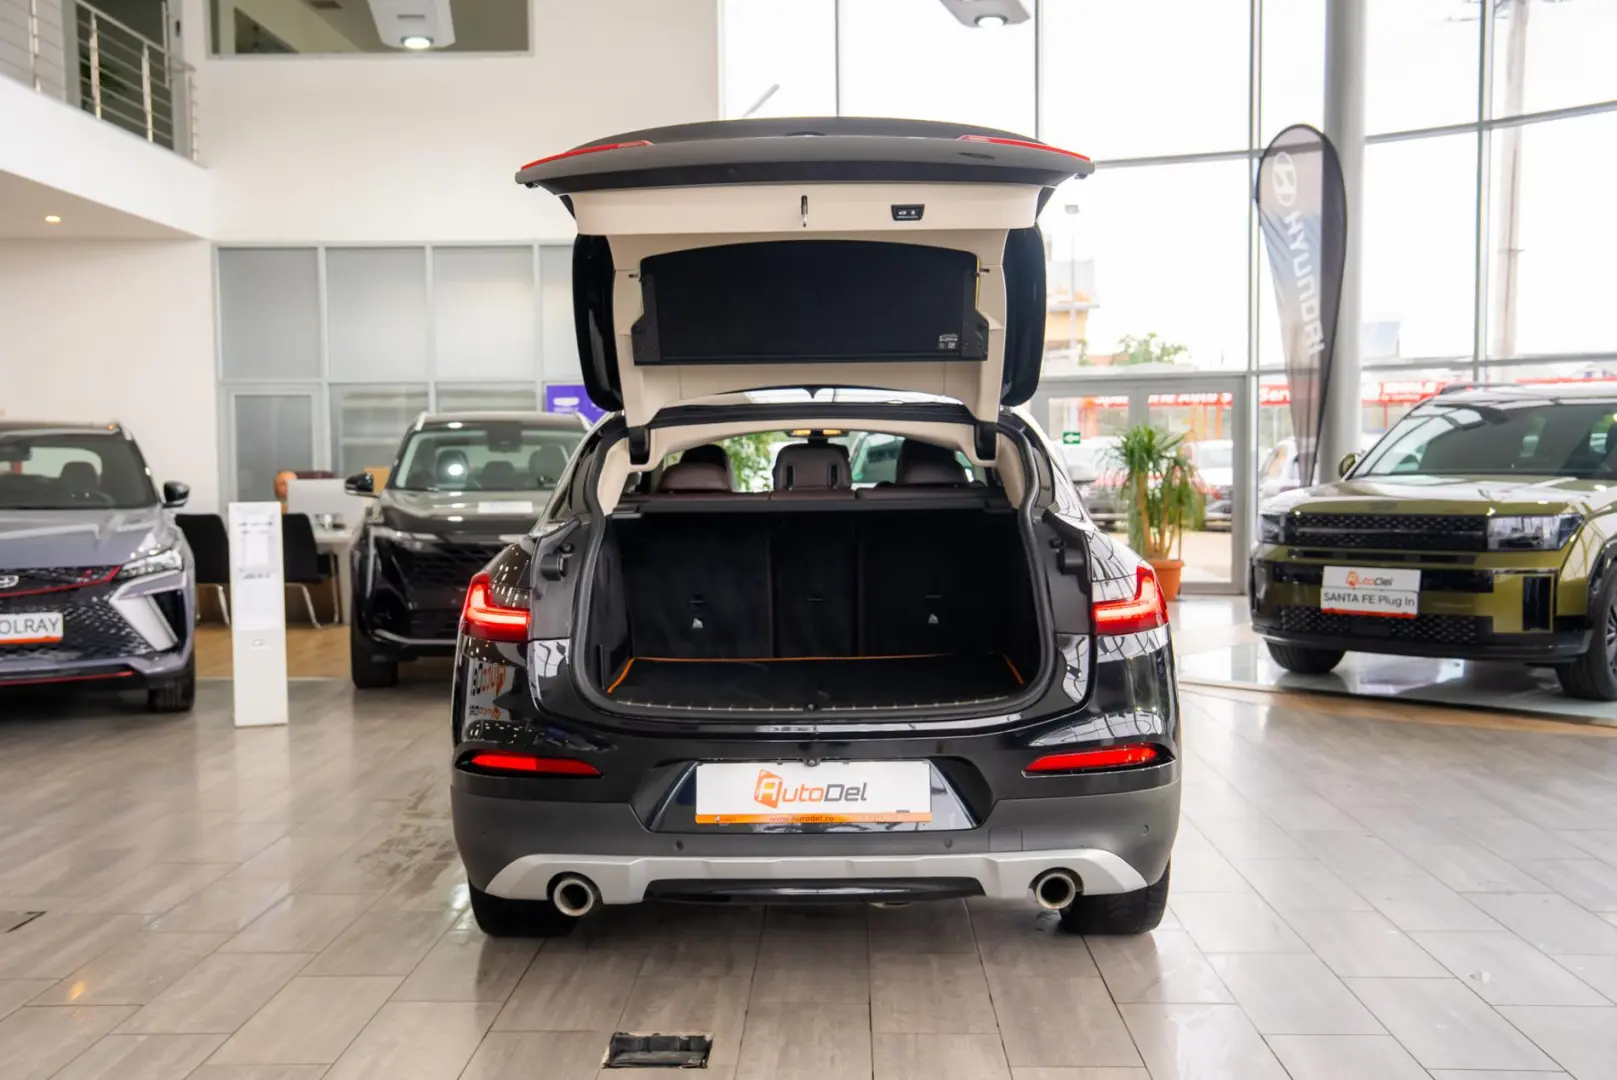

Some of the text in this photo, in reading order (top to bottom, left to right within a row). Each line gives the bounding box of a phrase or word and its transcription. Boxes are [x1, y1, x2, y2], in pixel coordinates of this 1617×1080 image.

[1323, 592, 1359, 603] SANTA
[1362, 594, 1376, 604] FE
[1378, 595, 1402, 607] Plug
[754, 768, 868, 809] AutoDel
